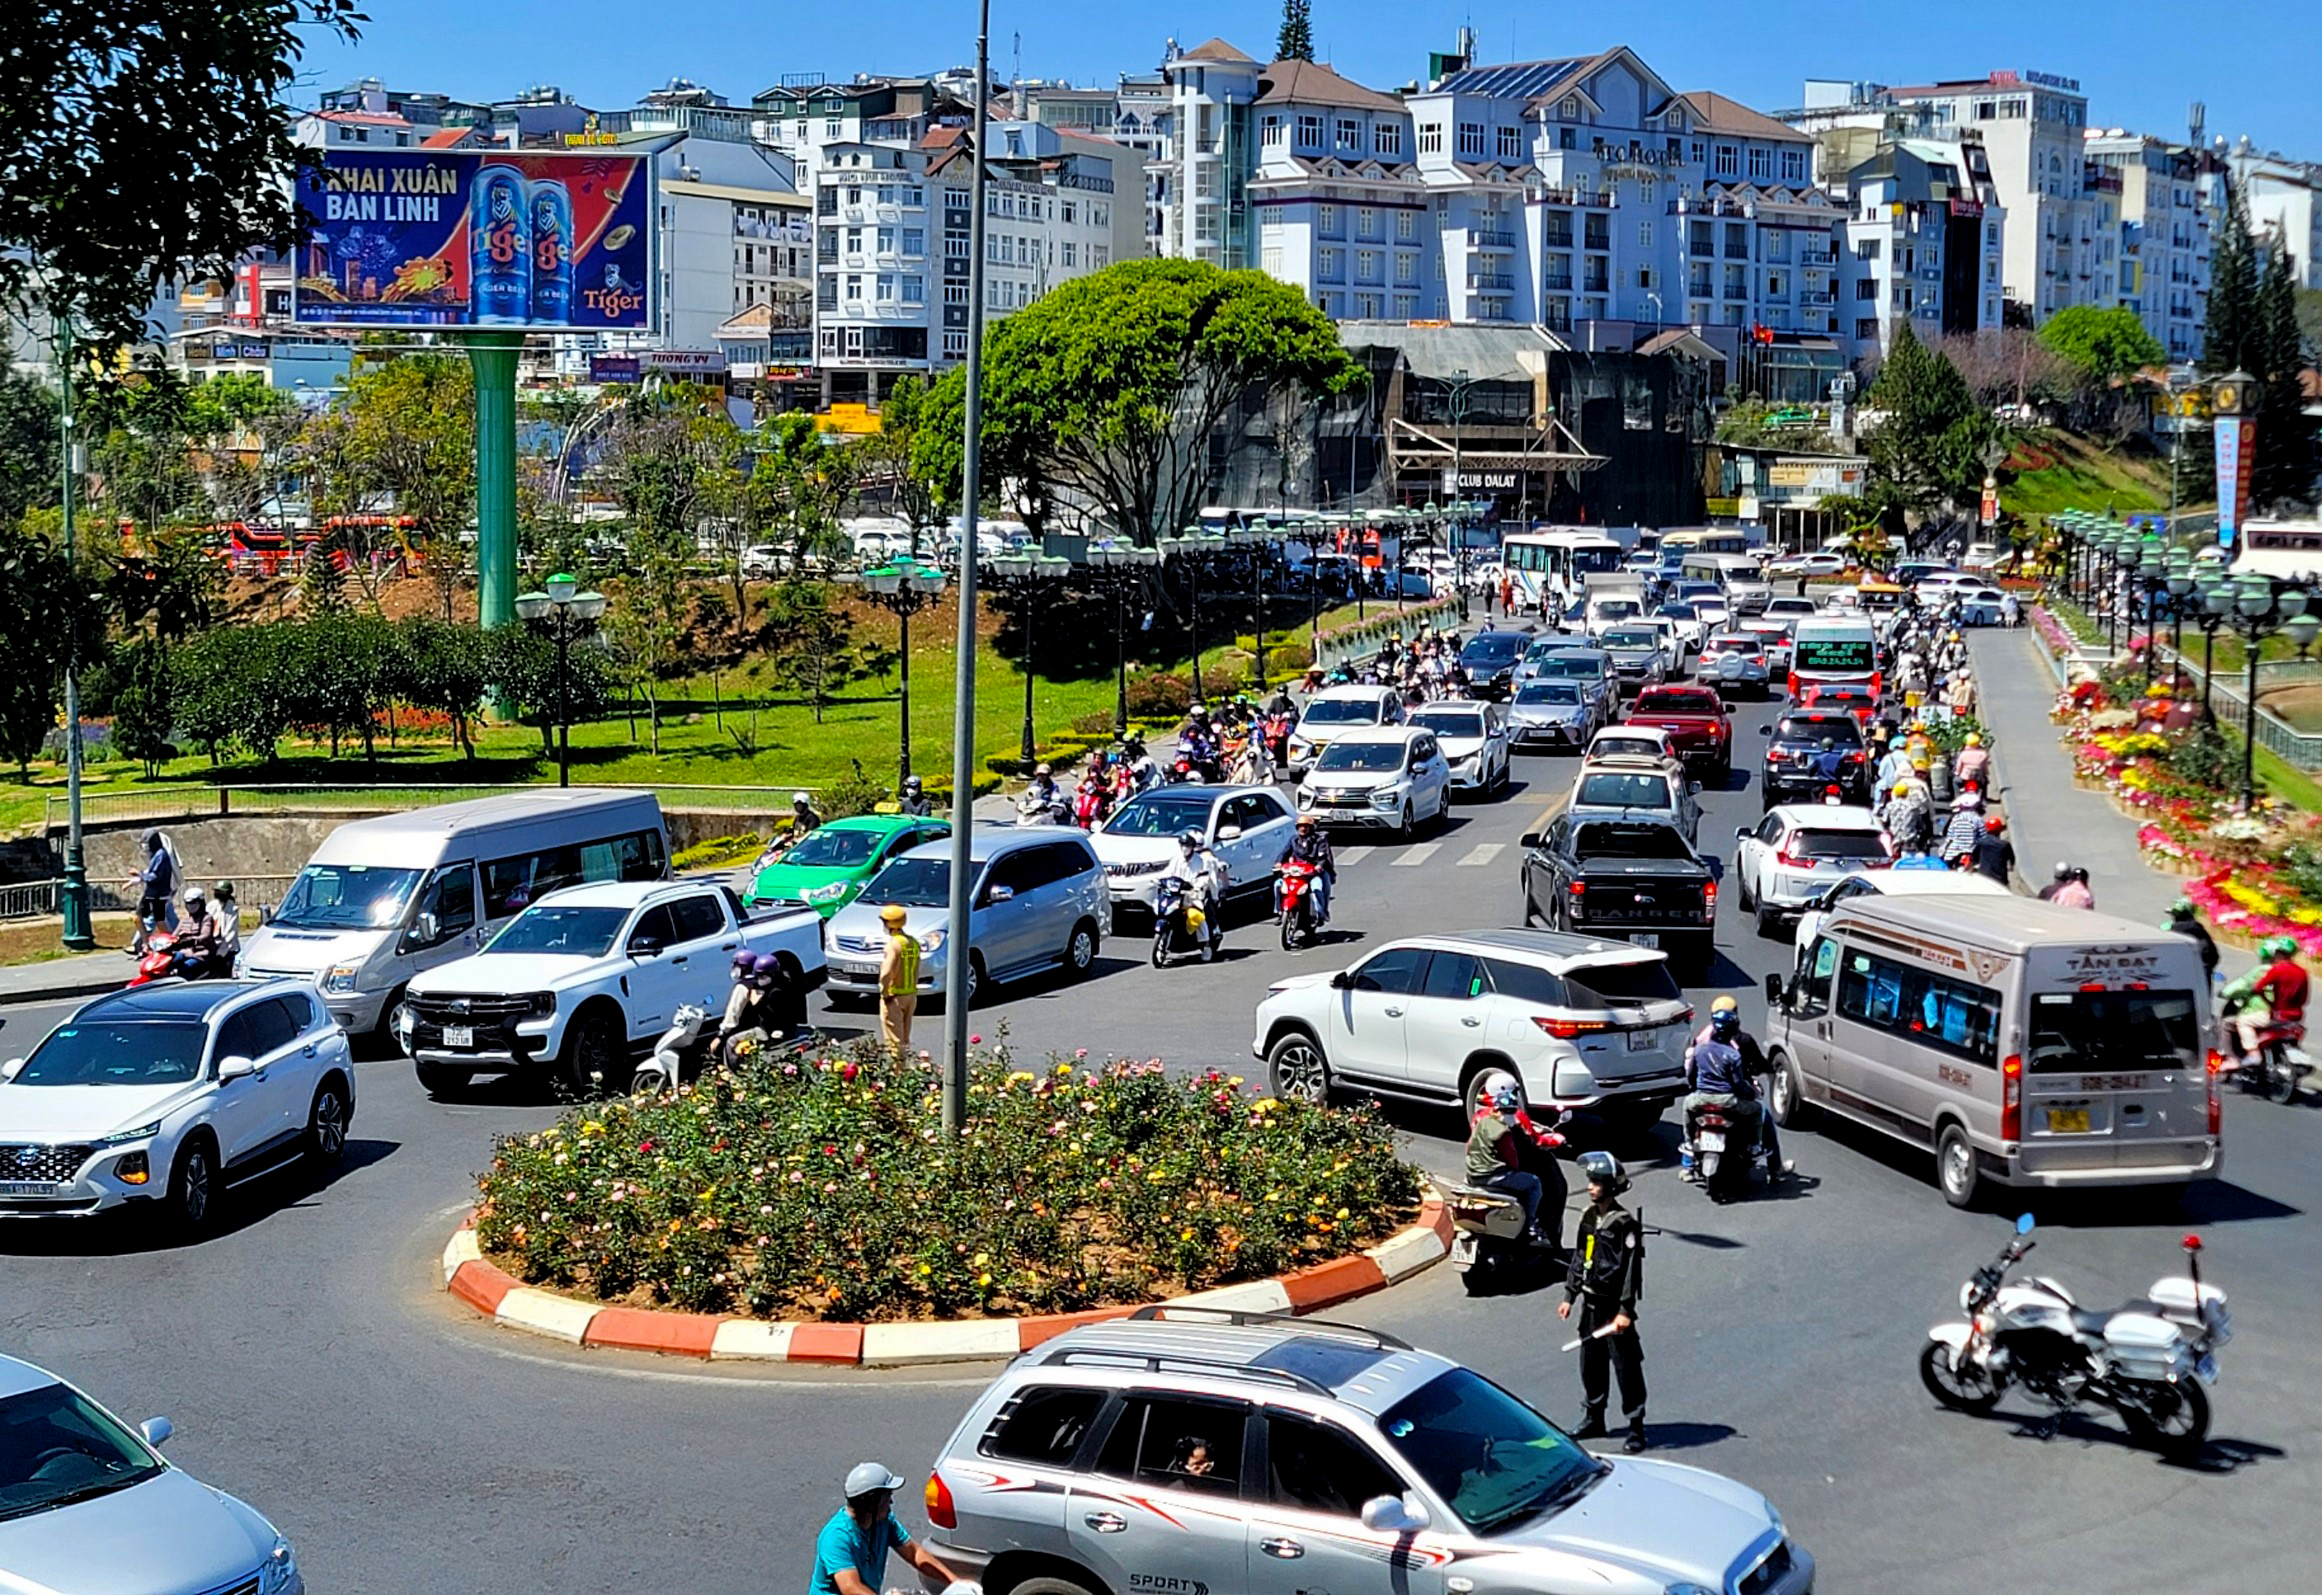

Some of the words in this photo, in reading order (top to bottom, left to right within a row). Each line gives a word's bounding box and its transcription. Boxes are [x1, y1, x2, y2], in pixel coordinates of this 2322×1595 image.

[326, 167, 385, 193] KHAI
[390, 162, 457, 194] XUÂN
[583, 288, 644, 319] Tiger
[1458, 474, 1482, 487] CLUB
[1485, 474, 1516, 488] DALAT
[2065, 955, 2111, 970] TÂN
[1129, 1573, 1190, 1591] SPORT
